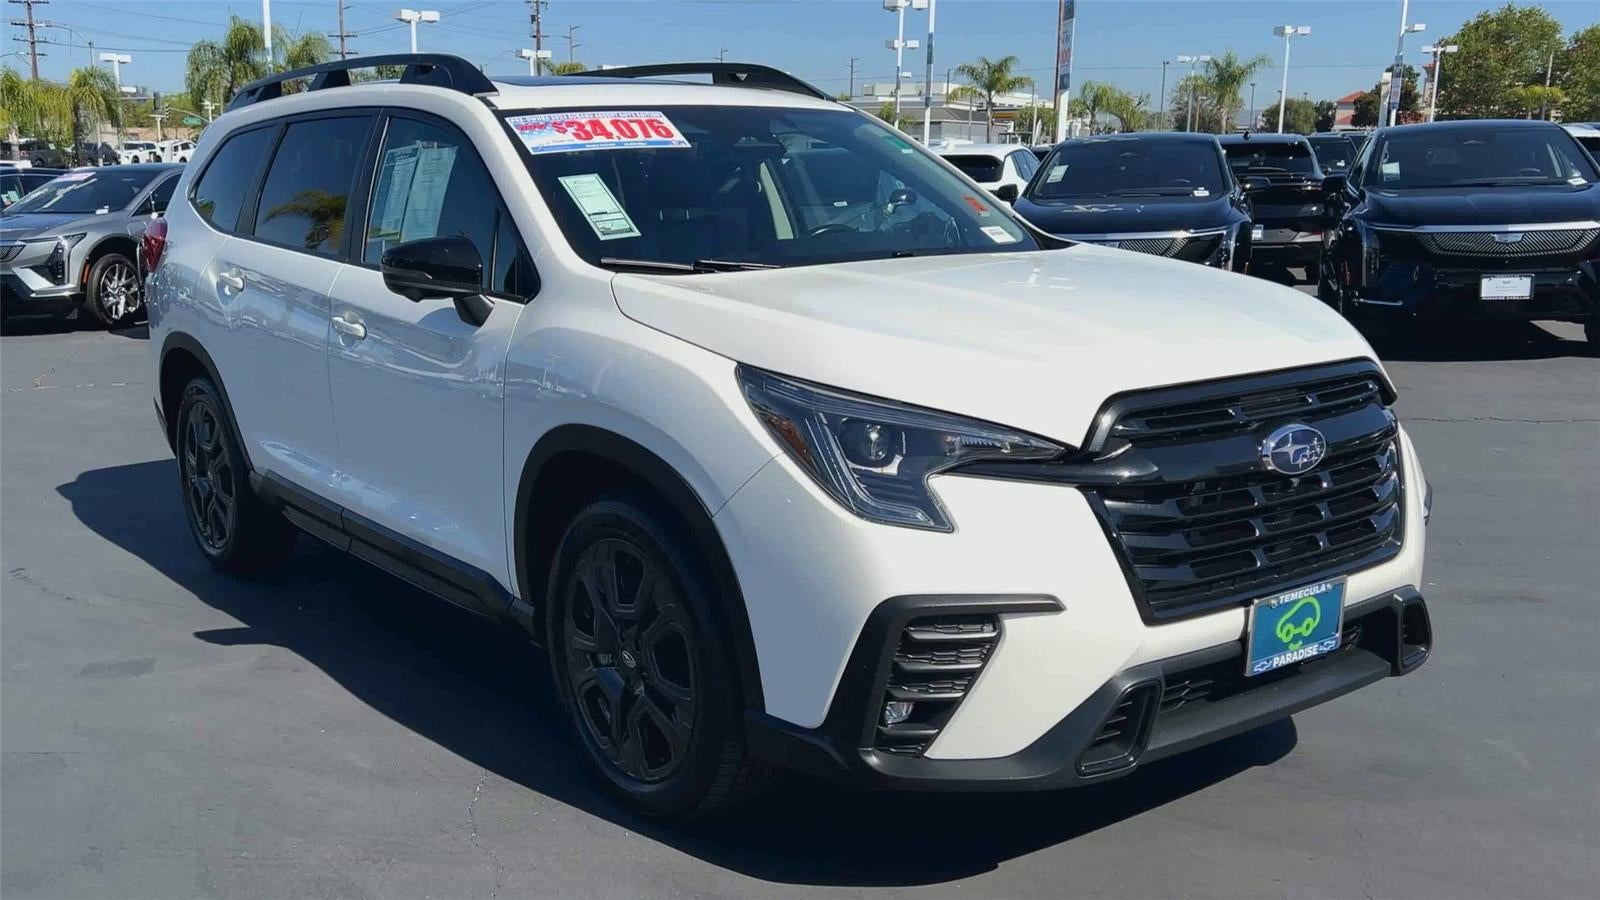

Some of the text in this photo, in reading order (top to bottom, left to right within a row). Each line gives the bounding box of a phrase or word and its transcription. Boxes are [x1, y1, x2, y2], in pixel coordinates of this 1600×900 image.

[551, 118, 674, 140] $34,076
[1279, 583, 1327, 604] TEMECULA
[1272, 645, 1319, 668] PARADISE
